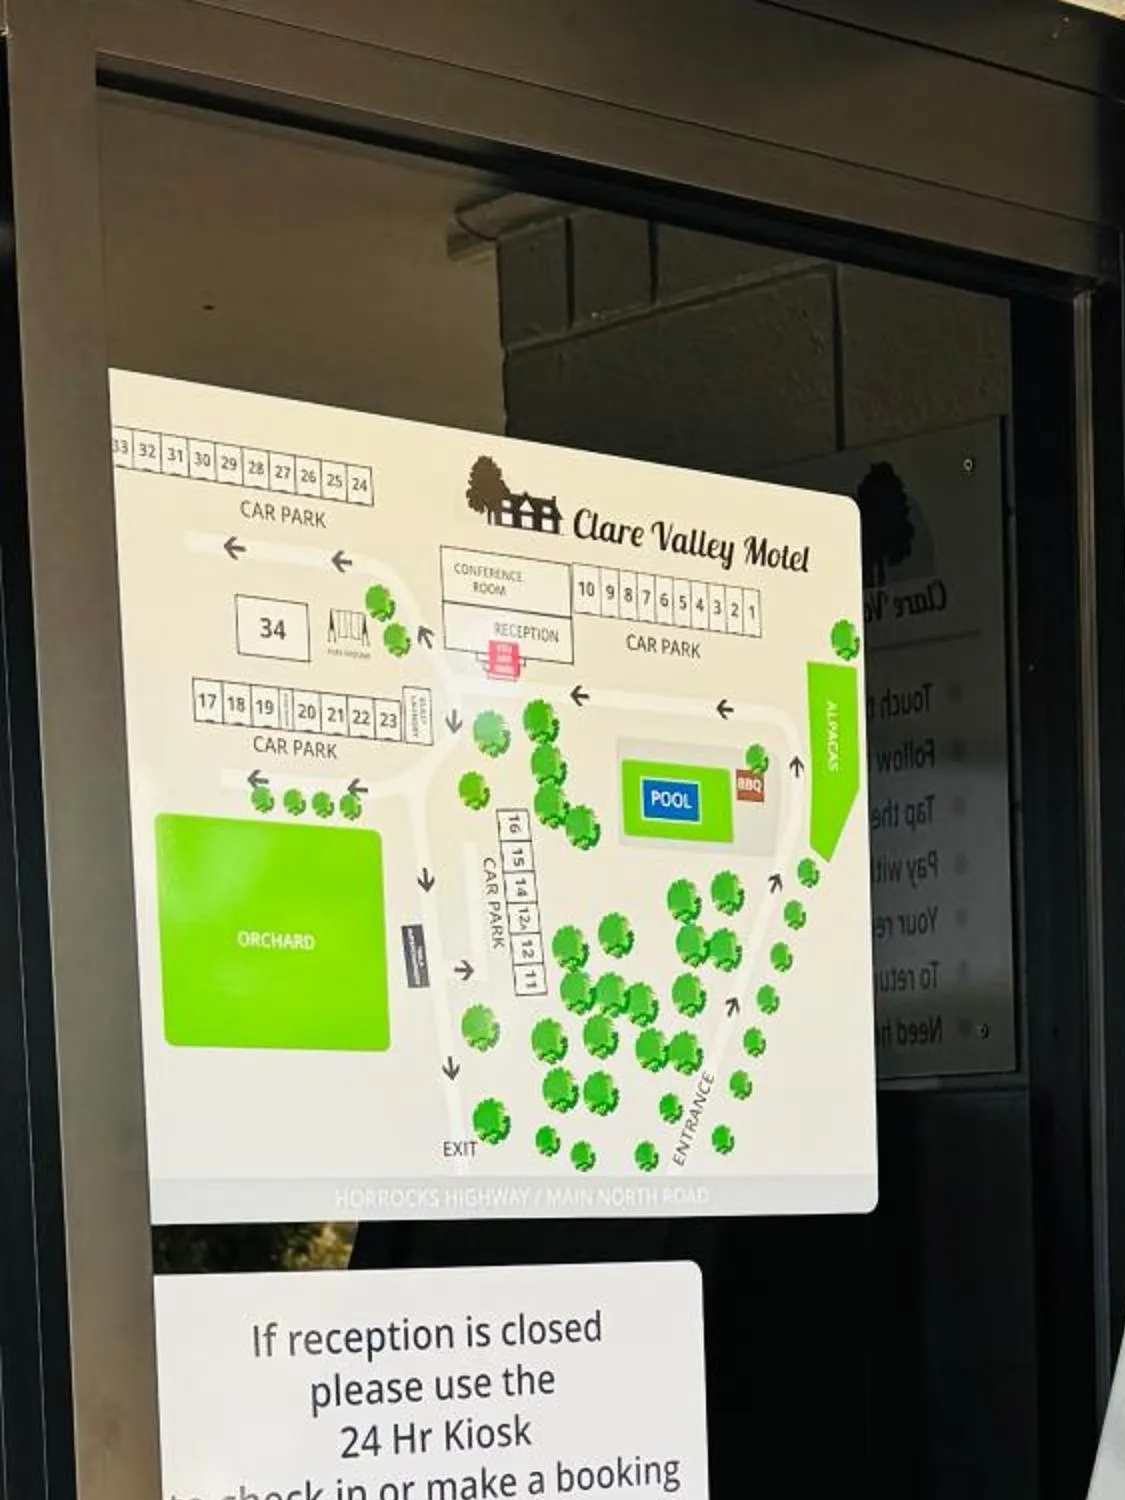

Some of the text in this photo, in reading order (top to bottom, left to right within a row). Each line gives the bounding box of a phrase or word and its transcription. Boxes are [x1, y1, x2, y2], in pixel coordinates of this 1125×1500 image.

[138, 442, 157, 460] 32
[167, 447, 184, 463] 31
[221, 455, 238, 471] 29
[274, 464, 291, 479] 27
[300, 468, 317, 484] 26
[326, 473, 343, 489] 25
[352, 477, 368, 493] 24
[240, 500, 326, 528] CAR PARK
[574, 508, 809, 572] Clare Valley Motel
[454, 562, 524, 584] CONFERENCE
[577, 580, 596, 597] 10
[605, 584, 615, 601] 9
[642, 589, 652, 605] 7
[679, 594, 688, 611] 5
[713, 599, 722, 616] 3
[730, 601, 739, 619] 2
[748, 605, 755, 620] 1
[260, 618, 286, 640] 34
[495, 622, 559, 643] RECEPTION
[626, 634, 700, 658] CAR PARK
[198, 692, 217, 709] 17
[226, 695, 246, 713] 18
[255, 699, 275, 715] 19
[297, 703, 317, 720] 20
[327, 706, 344, 723] 21
[352, 709, 371, 726] 22
[379, 711, 398, 729] 23
[254, 736, 336, 759] CAR PARK
[737, 776, 762, 792] BBQ
[651, 790, 692, 808] POOL
[484, 858, 506, 948] CAR PARK
[238, 931, 315, 950] ORCHARD
[672, 1072, 715, 1167] ENTRANCE
[443, 1141, 478, 1157] EXIT
[335, 1187, 657, 1210] HORROCKS HIGHWAY MAIN NORTH
[254, 1310, 601, 1362] If reception is closed
[312, 1365, 554, 1418] please use the
[341, 1414, 531, 1458] 24 Hr Kiosk
[528, 1472, 544, 1495] a
[557, 1456, 680, 1493] booking
